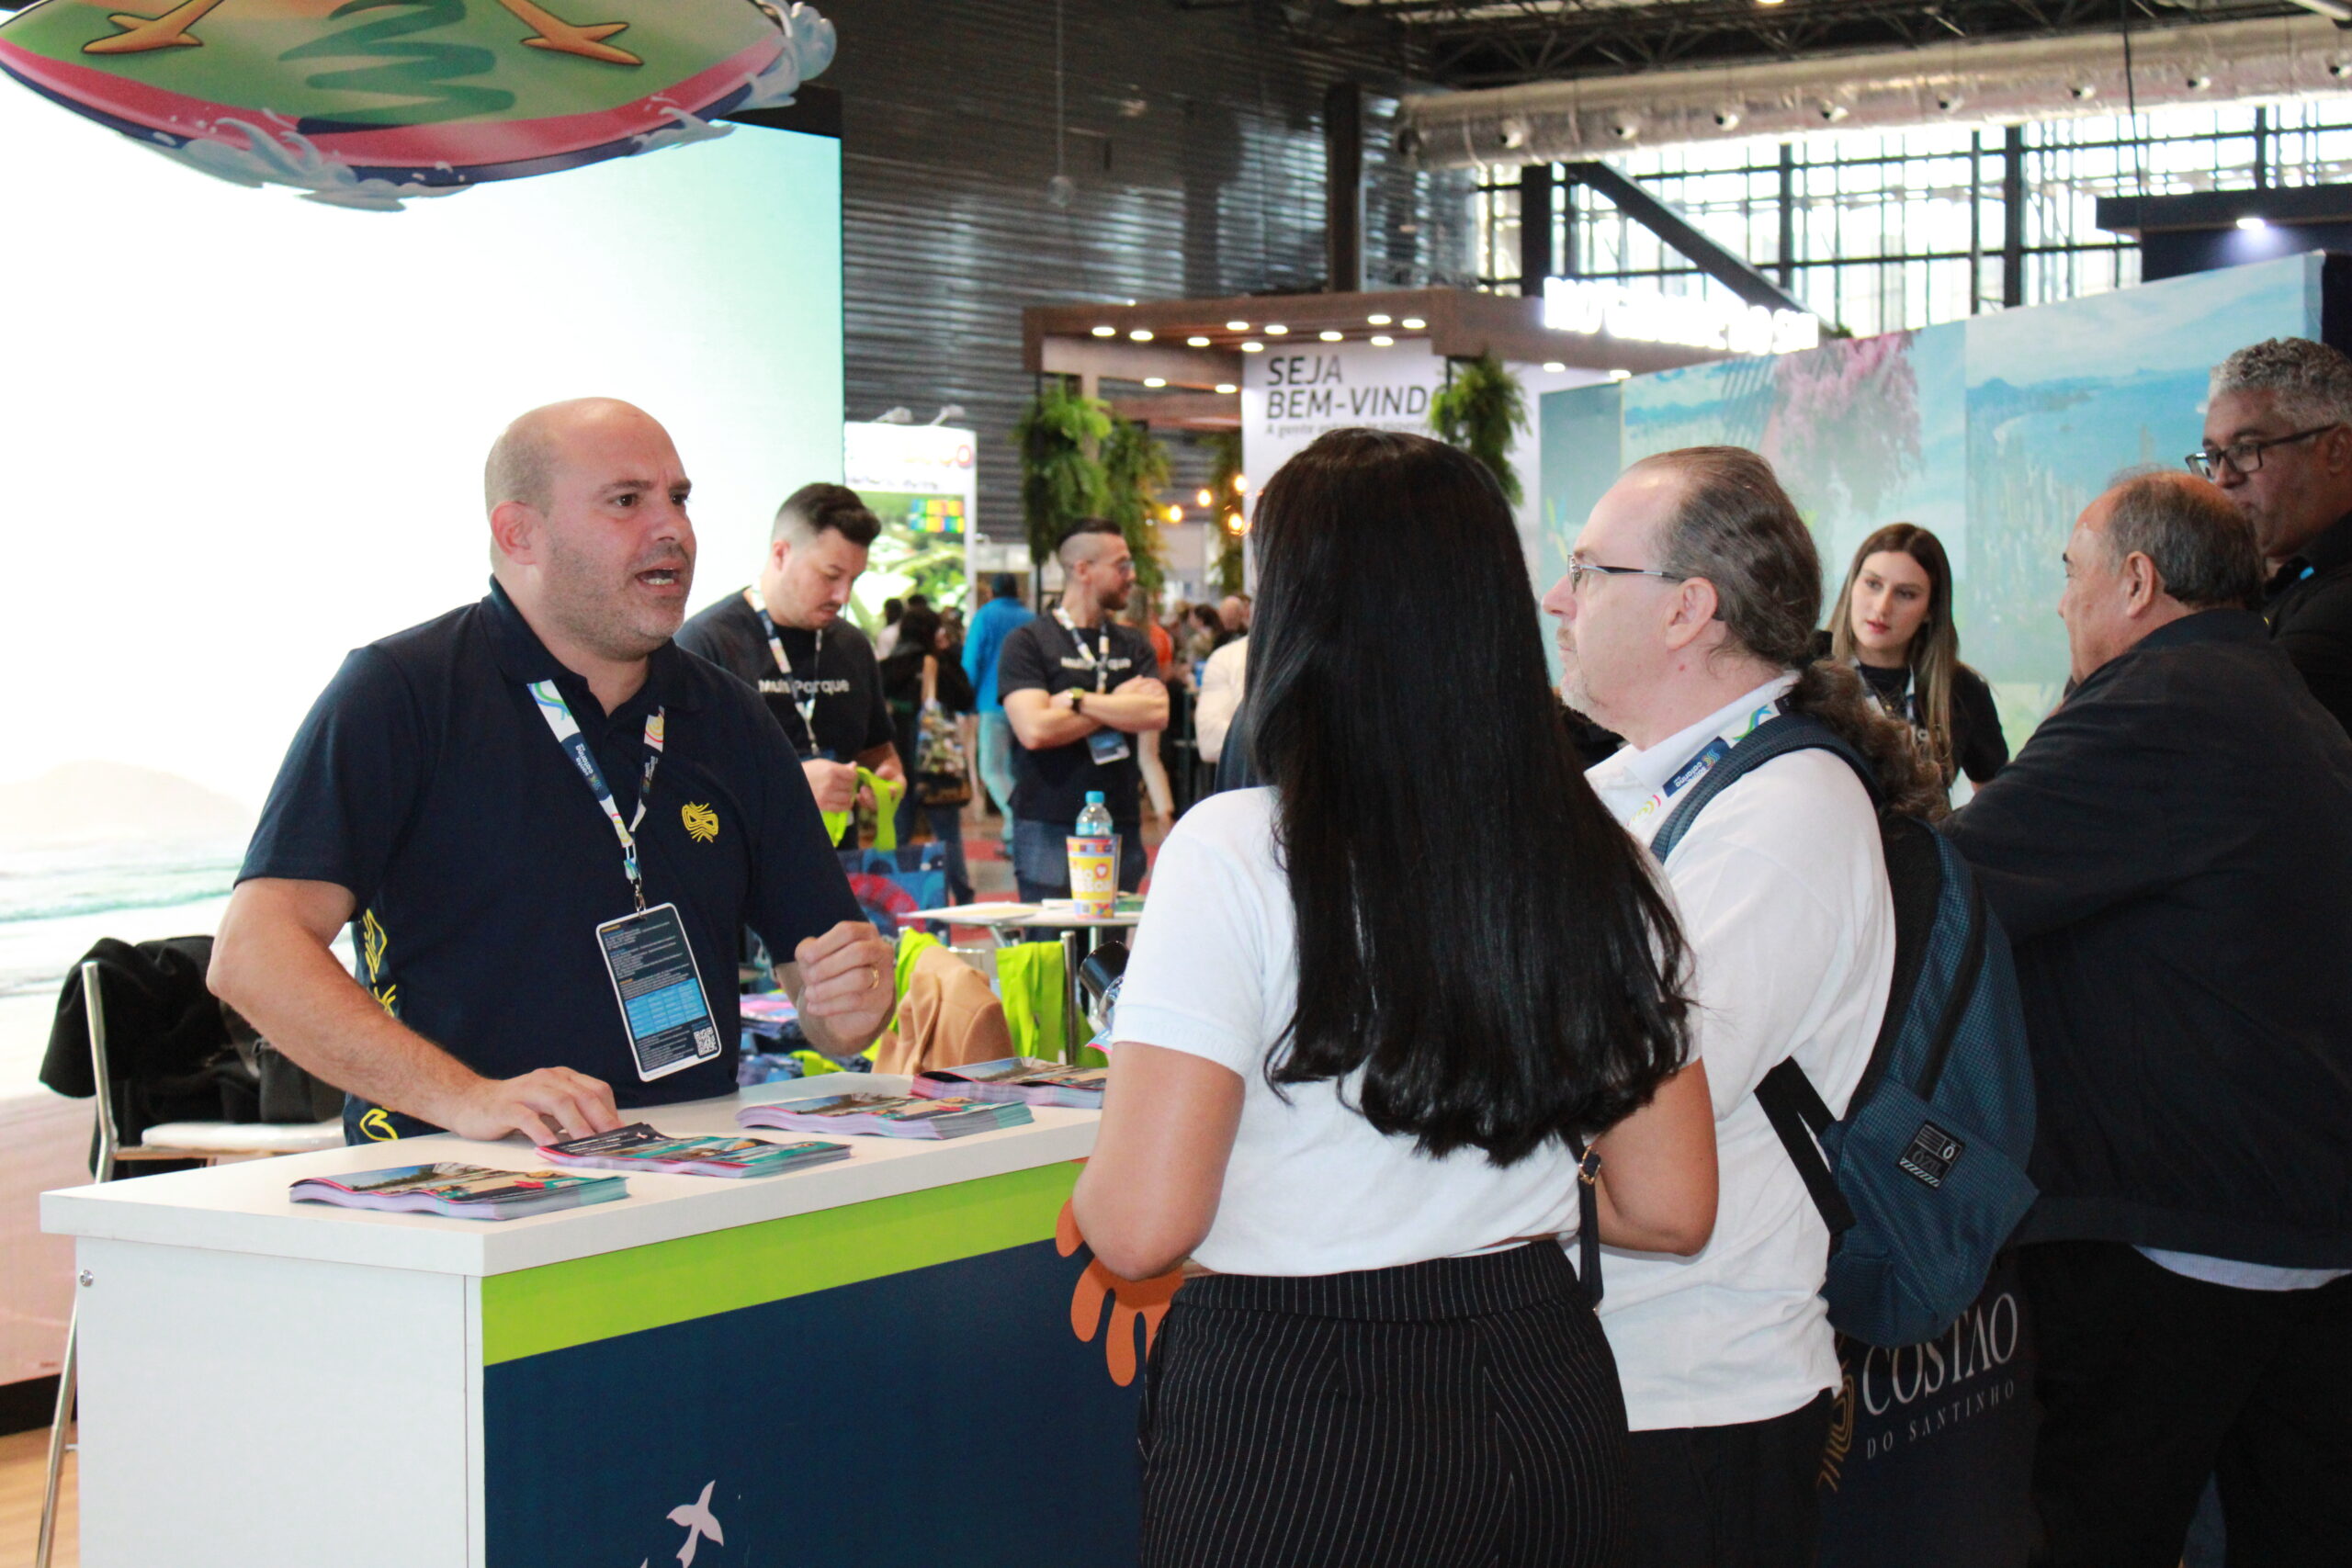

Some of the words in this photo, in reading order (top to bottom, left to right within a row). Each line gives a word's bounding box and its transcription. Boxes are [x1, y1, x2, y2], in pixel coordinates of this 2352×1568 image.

[1266, 355, 1343, 387] SEJA
[1266, 386, 1430, 420] BEM-VIND
[1867, 1430, 1894, 1461] DO
[1908, 1380, 2014, 1441] SANTINHO
